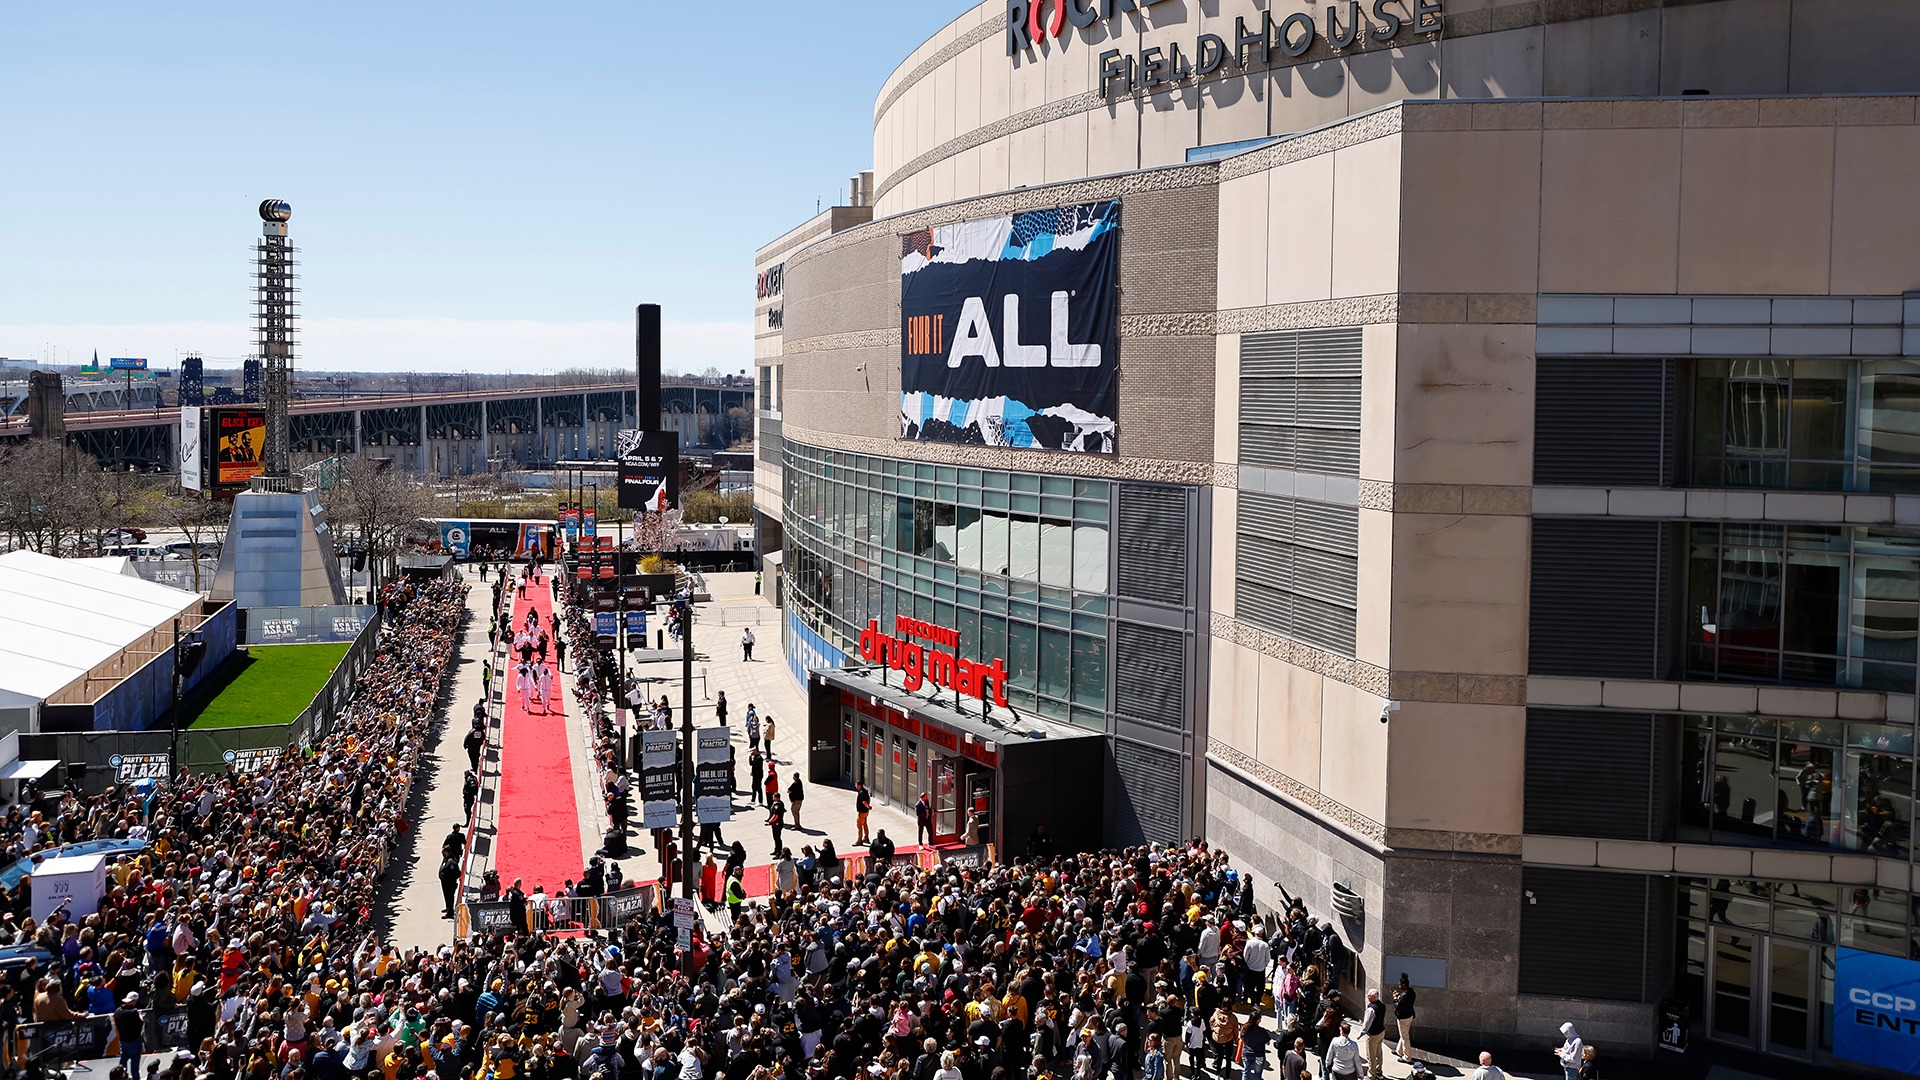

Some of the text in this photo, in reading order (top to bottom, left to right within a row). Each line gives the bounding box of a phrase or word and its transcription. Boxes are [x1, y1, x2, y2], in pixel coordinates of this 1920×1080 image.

[1099, 0, 1443, 98] FIELDHOUSE
[907, 290, 1101, 368] FOUR IT ALL
[221, 417, 245, 427] BLACK
[896, 614, 961, 648] DISCOUNT
[860, 618, 924, 692] drug
[928, 649, 1009, 708] mart
[647, 743, 672, 752] PRACTICE
[701, 740, 726, 748] PRACTICE
[154, 755, 167, 763] THE
[236, 751, 256, 759] PARTY
[120, 763, 168, 779] PLAZA
[545, 1001, 557, 1010] 22
[1850, 987, 1916, 1011] CCP
[524, 1014, 538, 1024] 23
[1856, 1009, 1920, 1035] ENT
